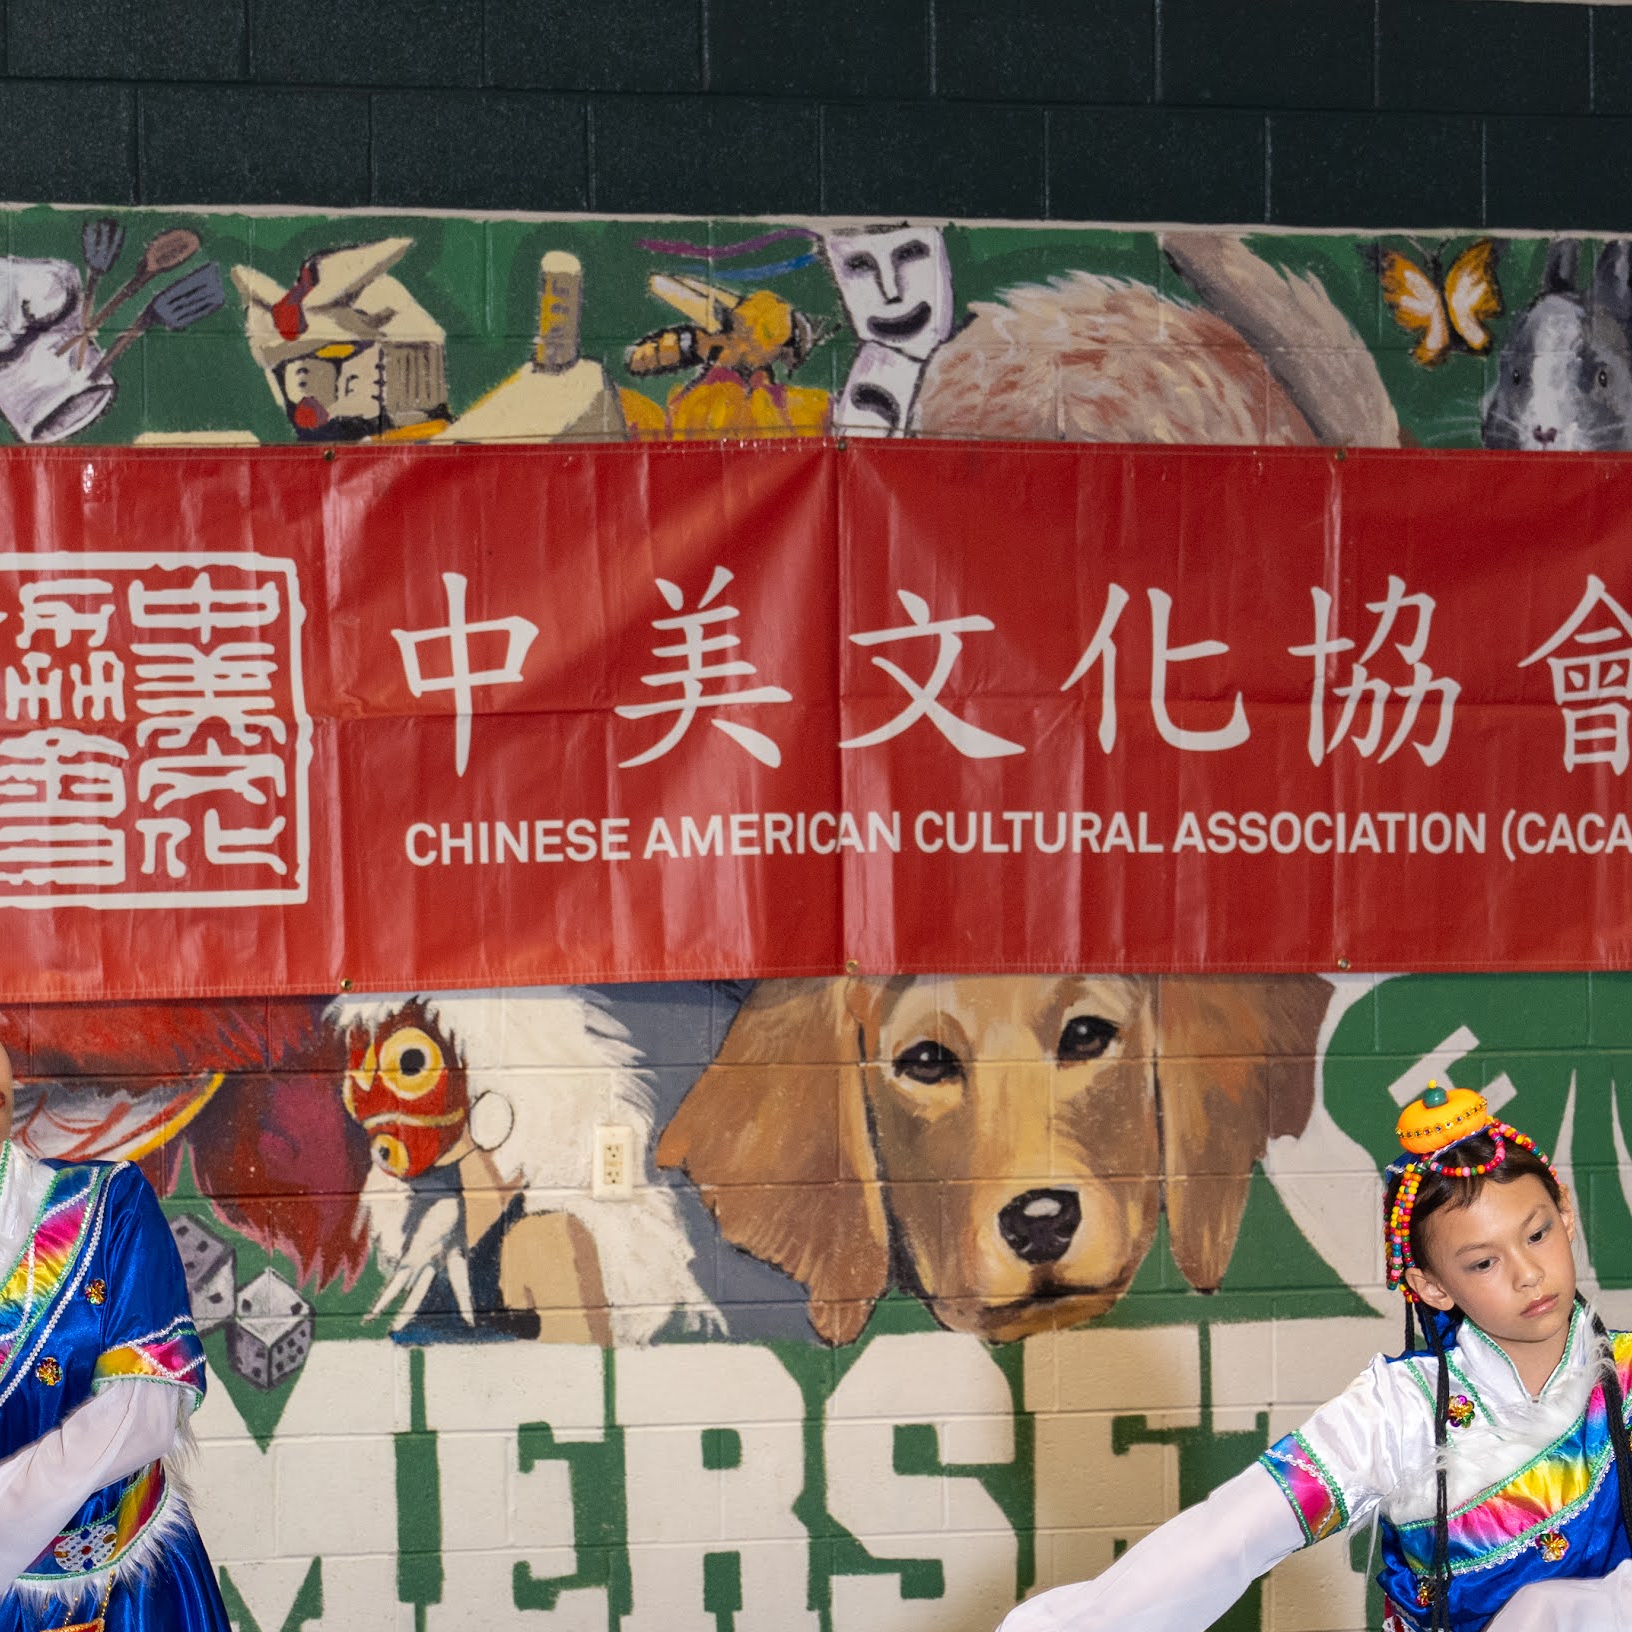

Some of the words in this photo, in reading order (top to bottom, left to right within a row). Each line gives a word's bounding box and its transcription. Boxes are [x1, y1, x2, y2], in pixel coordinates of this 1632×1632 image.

[404, 818, 631, 867] CHINESE
[643, 810, 902, 860] AMERICAN
[914, 810, 1164, 854] CULTURAL
[1171, 810, 1487, 855] ASSOCIATION
